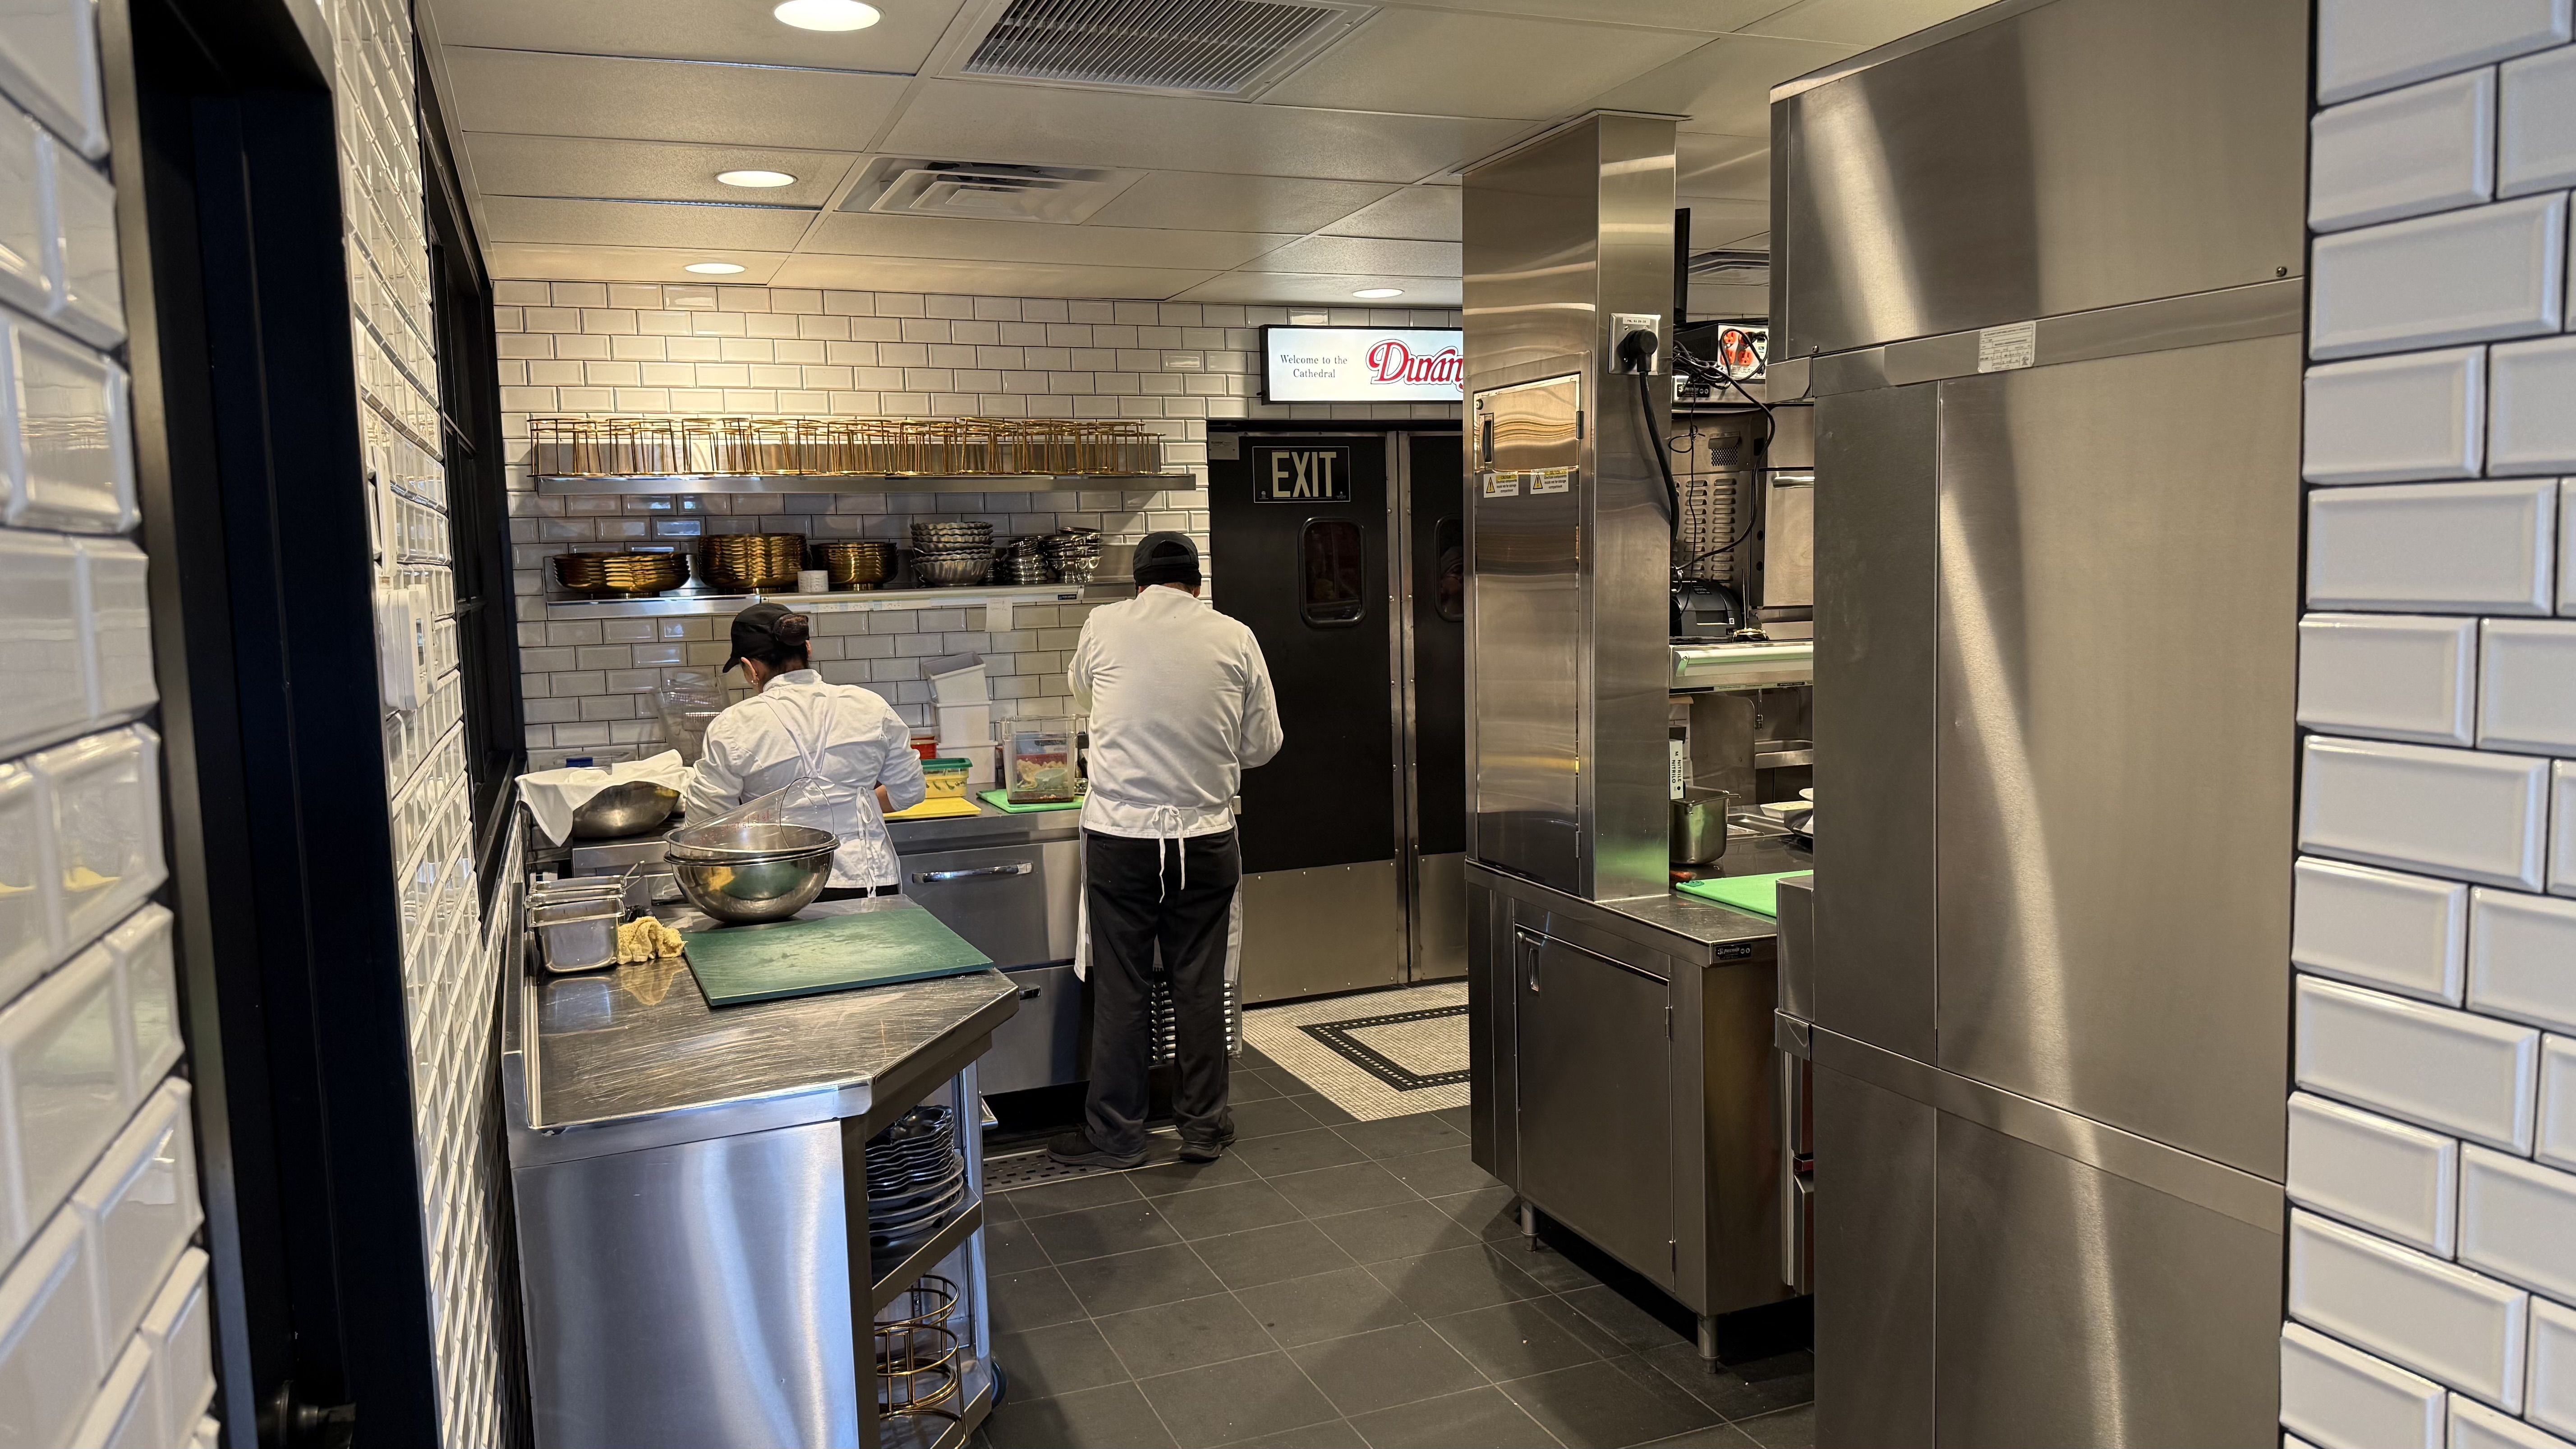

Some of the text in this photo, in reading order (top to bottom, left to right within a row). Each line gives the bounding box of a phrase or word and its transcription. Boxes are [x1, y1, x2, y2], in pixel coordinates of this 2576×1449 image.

[1280, 354, 1319, 364] Welcome
[1334, 355, 1348, 364] the
[1293, 368, 1335, 377] Cathedral
[1272, 451, 1337, 497] EXIT
